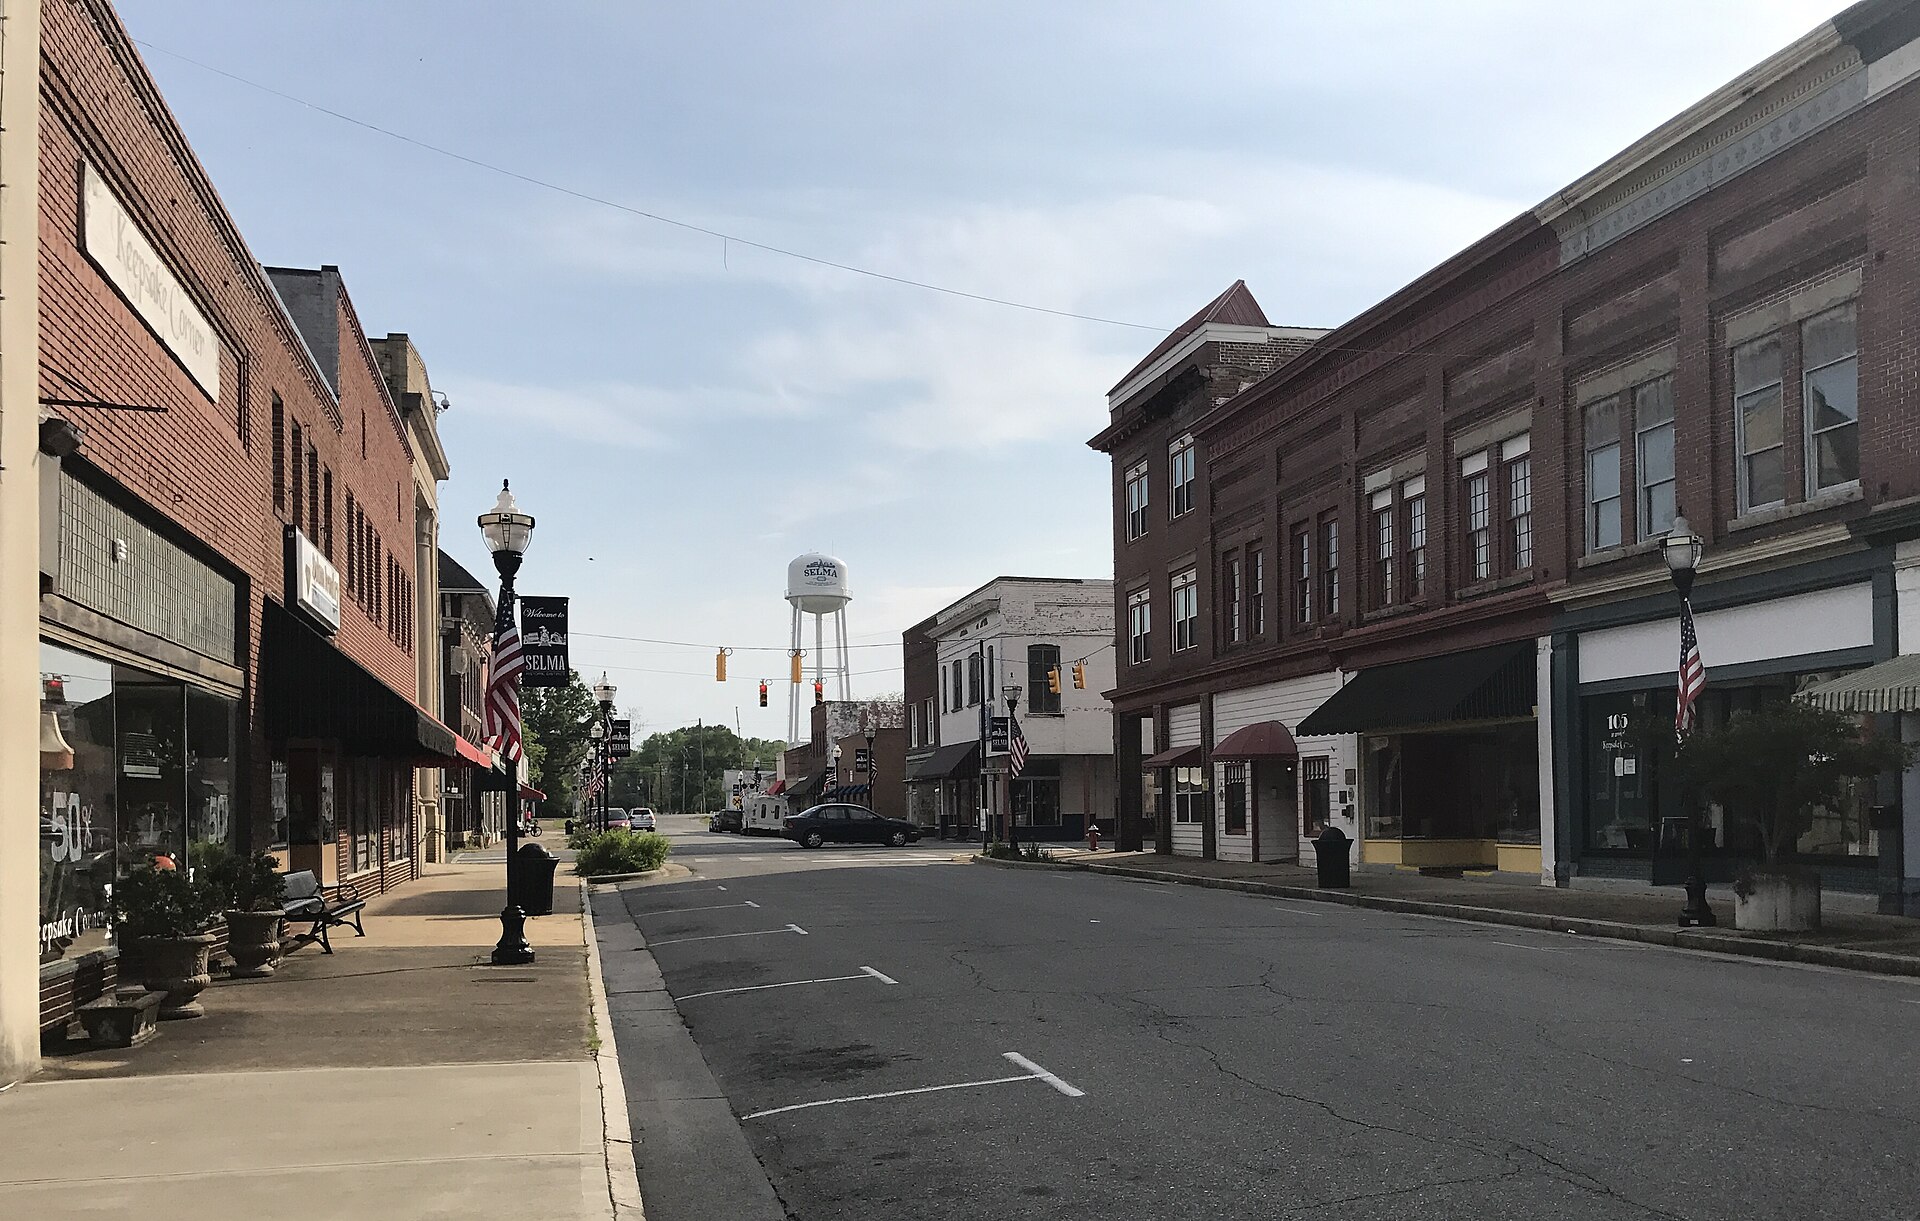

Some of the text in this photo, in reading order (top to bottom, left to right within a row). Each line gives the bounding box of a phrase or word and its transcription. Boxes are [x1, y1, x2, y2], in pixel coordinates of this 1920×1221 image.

[111, 205, 205, 357] Keepsake Corner
[804, 567, 838, 578] SELMA
[523, 607, 557, 618] Welcome
[525, 654, 566, 671] SELMA
[1607, 713, 1629, 730] 105
[51, 791, 94, 863] 50%
